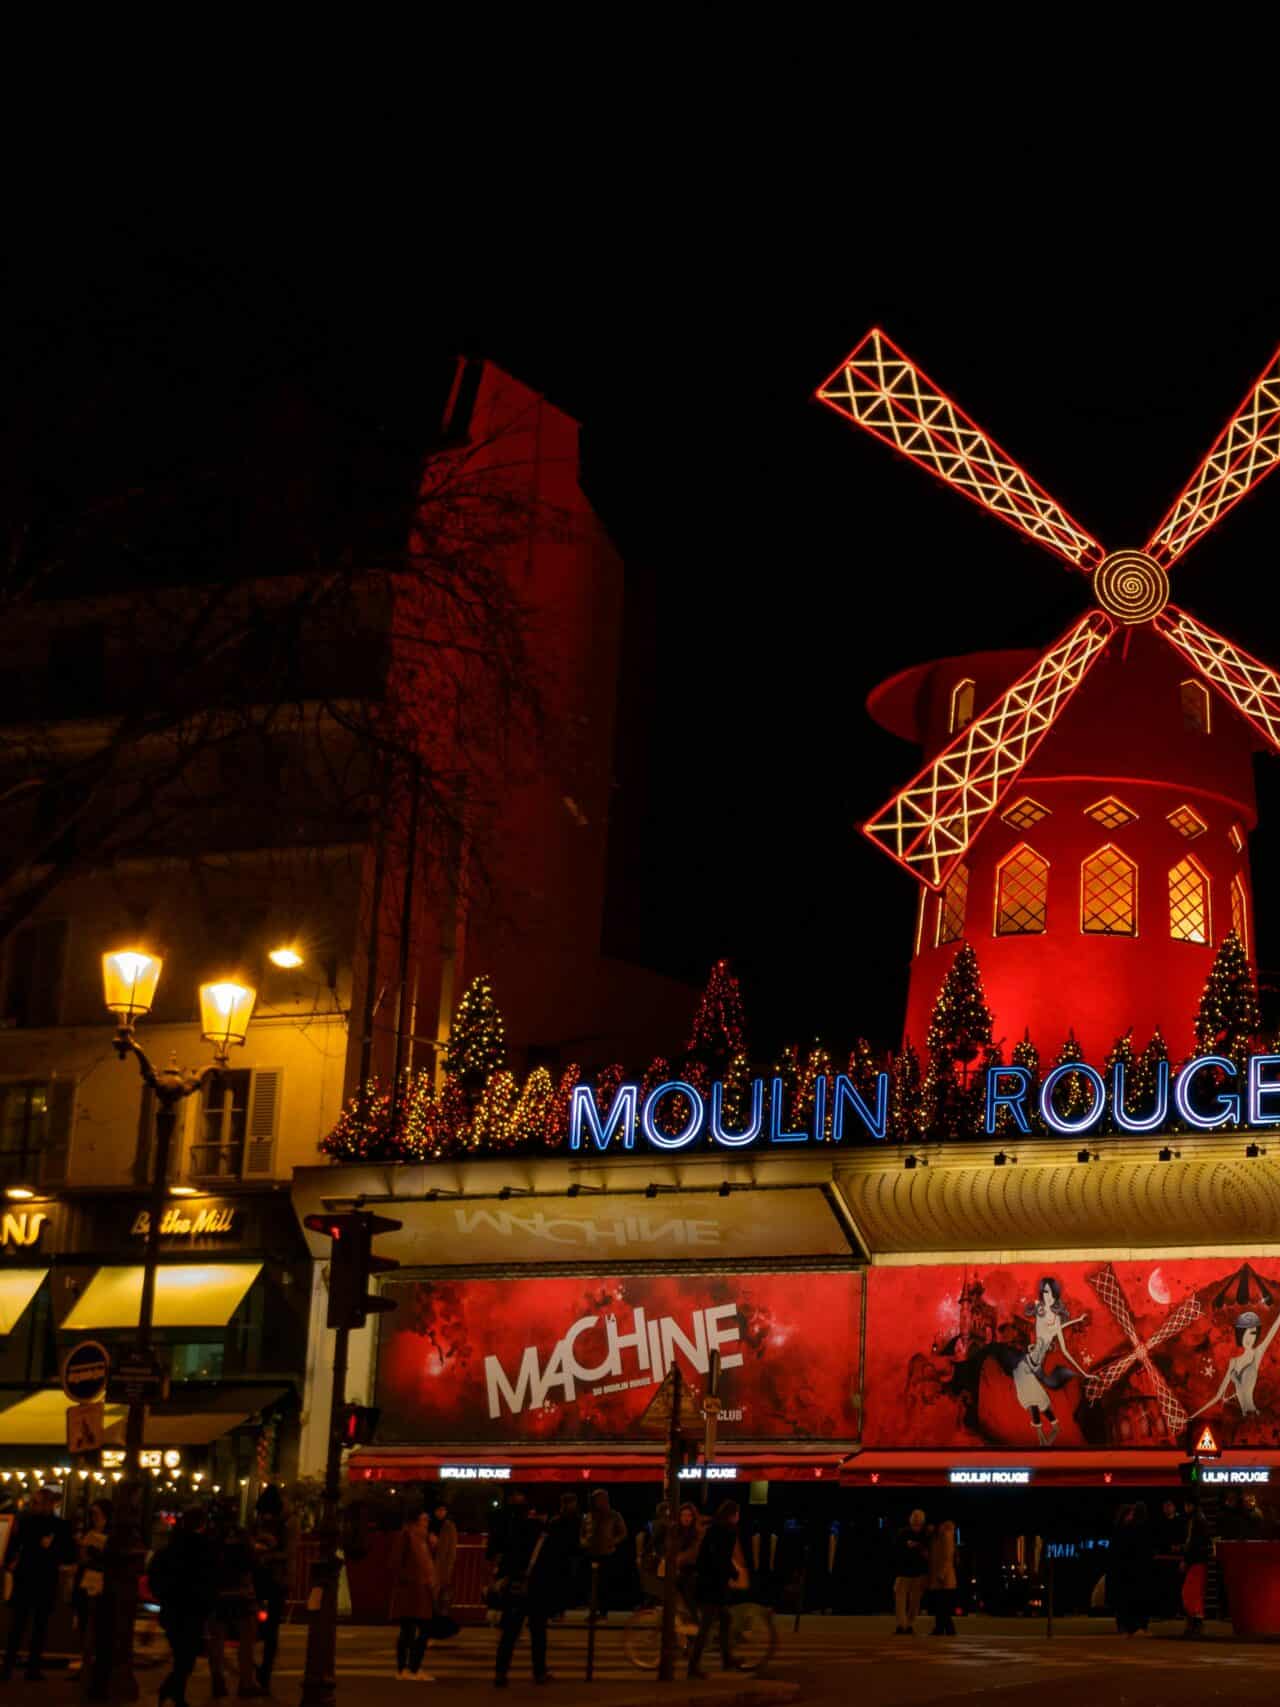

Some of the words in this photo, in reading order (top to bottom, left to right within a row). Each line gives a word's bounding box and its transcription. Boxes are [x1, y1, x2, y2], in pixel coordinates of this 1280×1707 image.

[570, 1073, 889, 1150] MOULIN
[0, 1213, 47, 1246] NS
[192, 1207, 235, 1234] Mill
[484, 1303, 744, 1419] MACHINE
[717, 1409, 743, 1421] CLUB
[950, 1471, 992, 1483] MOULIN
[992, 1471, 1029, 1483] ROUGE
[1202, 1471, 1229, 1483] ULIN
[1230, 1471, 1269, 1483] ROUGE
